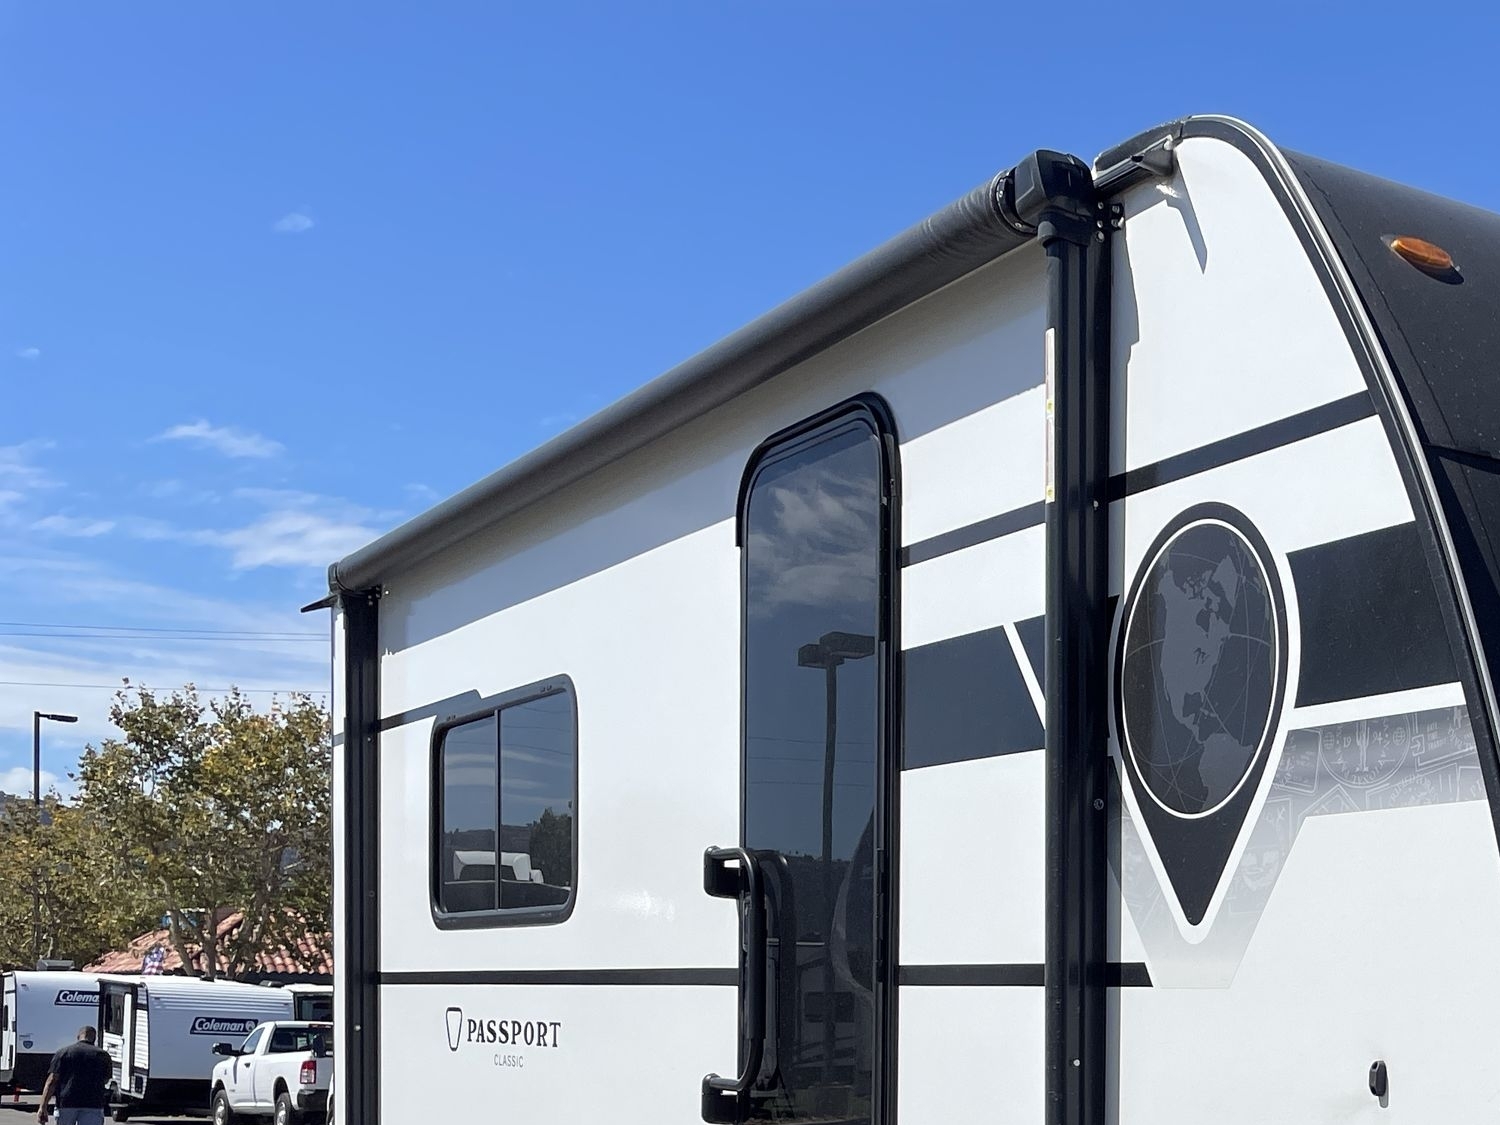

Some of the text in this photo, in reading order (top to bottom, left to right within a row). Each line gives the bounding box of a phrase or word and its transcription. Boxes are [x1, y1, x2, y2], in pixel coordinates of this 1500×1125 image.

[59, 991, 99, 1003] Colema
[194, 1017, 244, 1032] Coleman
[467, 1018, 561, 1048] PASSPORT
[494, 1054, 524, 1068] CLASSIC
